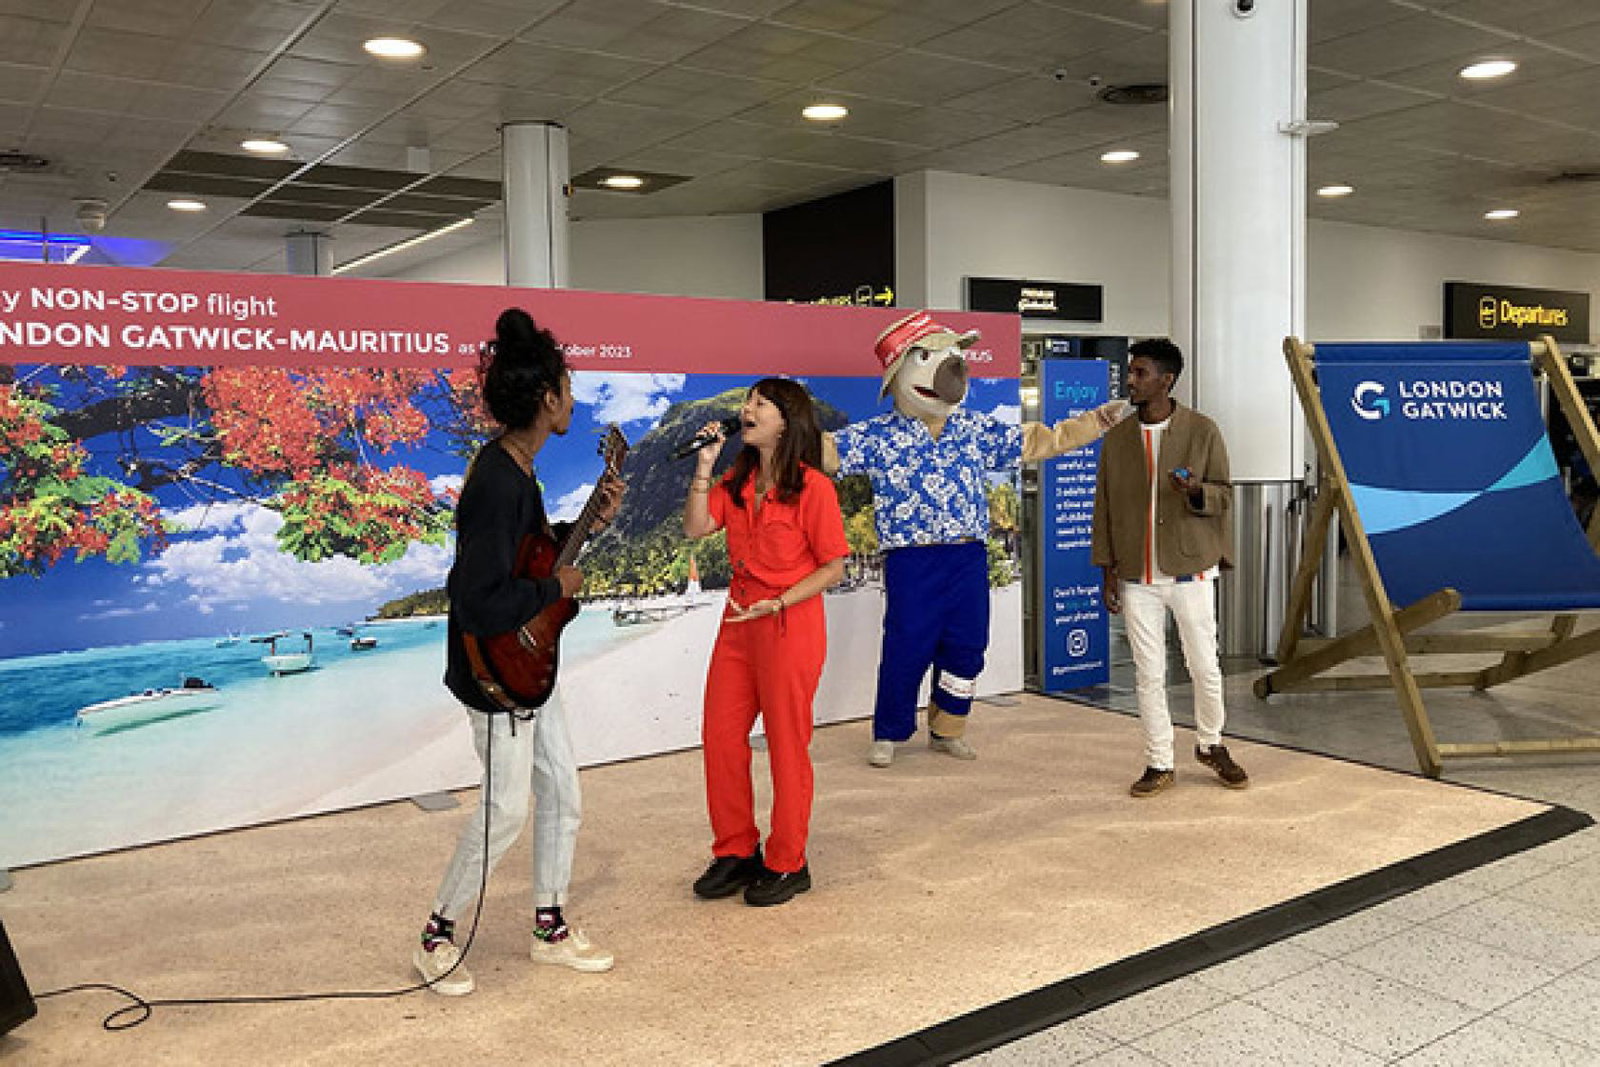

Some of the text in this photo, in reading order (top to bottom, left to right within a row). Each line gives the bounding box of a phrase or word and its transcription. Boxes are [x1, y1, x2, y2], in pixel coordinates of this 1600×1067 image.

[31, 287, 199, 313] NON-STOP
[207, 293, 278, 320] flight
[1500, 300, 1569, 328] Departures
[121, 324, 450, 353] GATWICK-MAURITIUS
[1055, 381, 1100, 403] Enjoy
[1399, 380, 1503, 399] LONDON
[1402, 402, 1507, 420] GATWICK
